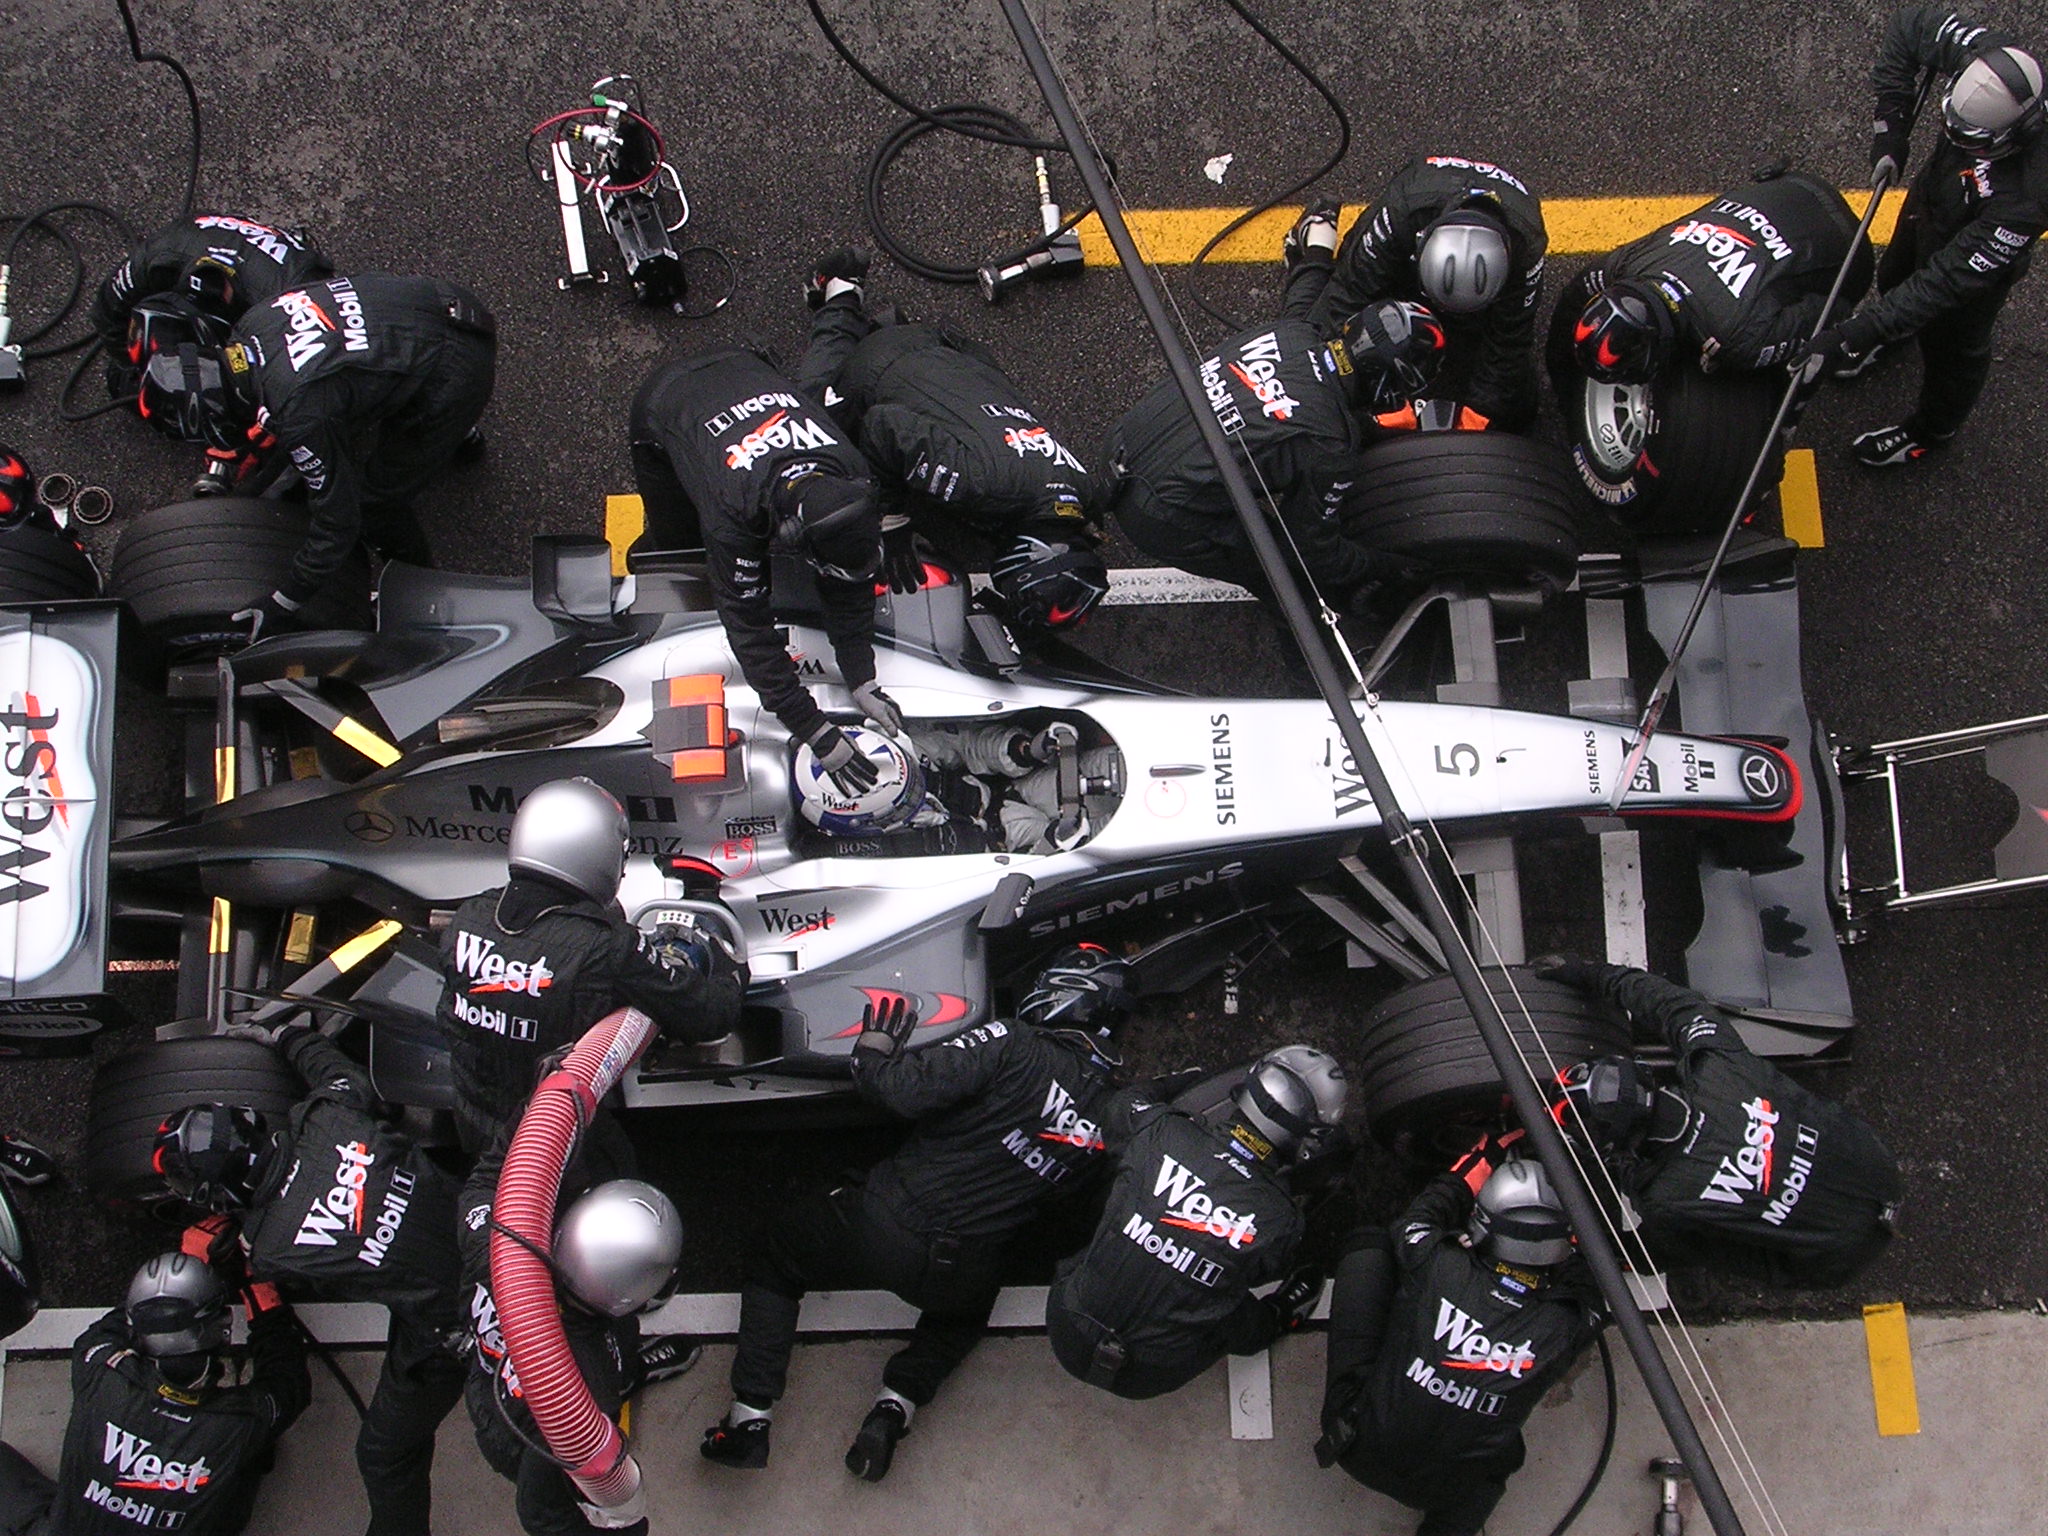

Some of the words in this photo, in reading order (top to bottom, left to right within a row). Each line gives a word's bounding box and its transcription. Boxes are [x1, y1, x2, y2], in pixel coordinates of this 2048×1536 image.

[1711, 199, 1742, 214] 1
[1734, 206, 1793, 261] Mobil
[326, 277, 352, 292] 1
[1669, 210, 1757, 299] West
[271, 290, 328, 372] West
[332, 291, 369, 351] Mobil
[1201, 356, 1234, 412] Mobil
[1239, 332, 1300, 418] West
[704, 411, 734, 437] 1
[730, 393, 800, 421] Mobil
[1217, 406, 1246, 436] 1
[726, 418, 838, 471] West
[1211, 713, 1237, 825] SIEMENS
[1434, 743, 1480, 777] 5
[1584, 730, 1601, 794] SIEMENS
[1681, 743, 1699, 793] Mobil
[0, 704, 59, 906] West
[728, 822, 775, 835] BOSS
[838, 841, 881, 855] BOSS
[758, 905, 835, 934] West
[1029, 861, 1244, 938] SIEMENS
[456, 930, 551, 997] West
[454, 993, 507, 1035] Mobil
[511, 1016, 538, 1041] 1
[1040, 1079, 1103, 1154] West
[1002, 1128, 1047, 1176] Mobil
[1699, 1096, 1780, 1204] West
[1761, 1155, 1813, 1226] Mobil
[1796, 1124, 1819, 1155] 1
[293, 1141, 375, 1246] West
[358, 1192, 409, 1267] Mobil
[390, 1166, 416, 1195] 1
[1153, 1154, 1257, 1250] West
[1122, 1212, 1197, 1273] Mobil
[1191, 1257, 1224, 1287] 1
[1433, 1296, 1535, 1379] West
[1405, 1356, 1479, 1410] Mobil
[1477, 1391, 1507, 1416] 1
[103, 1420, 210, 1494] West
[83, 1479, 155, 1526] Mobil
[155, 1509, 187, 1529] 1
